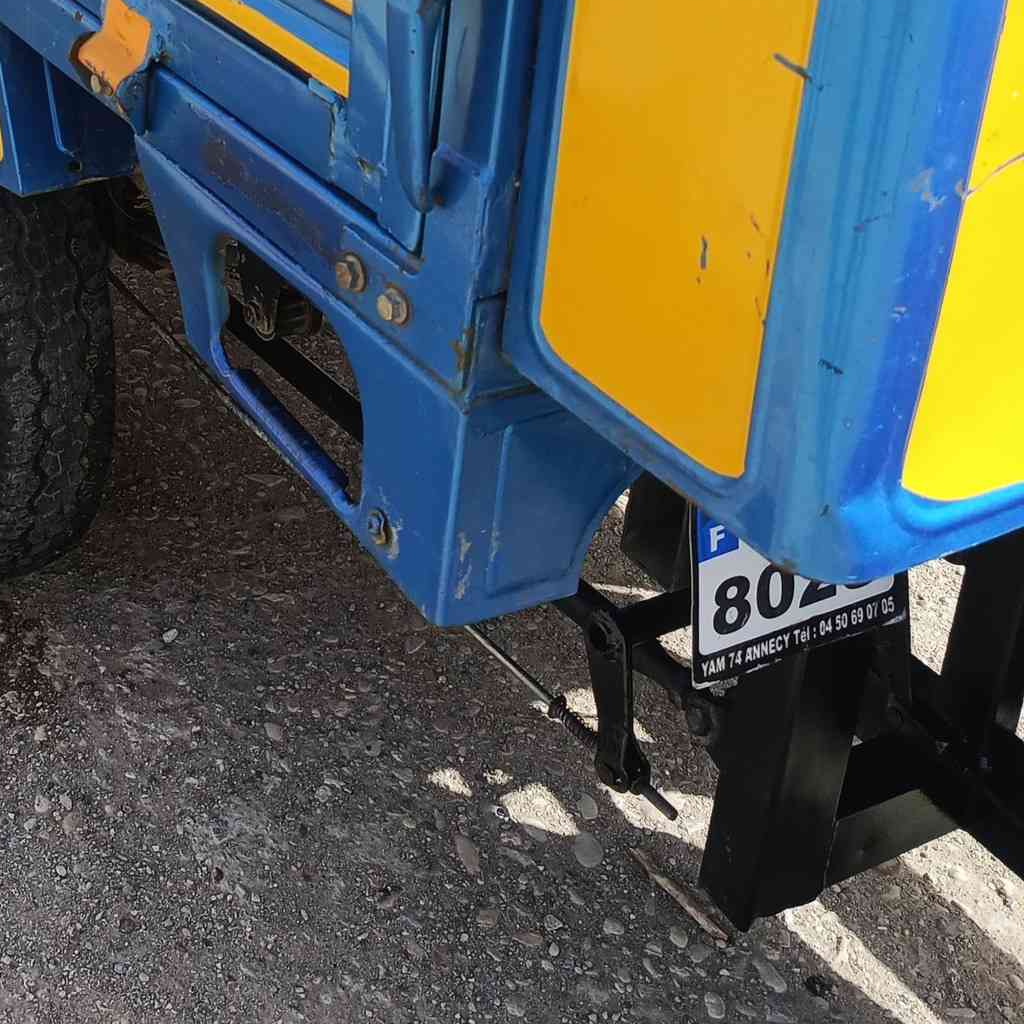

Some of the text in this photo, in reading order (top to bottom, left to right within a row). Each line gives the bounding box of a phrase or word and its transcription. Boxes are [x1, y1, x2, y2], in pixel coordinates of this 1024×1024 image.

[709, 525, 725, 553] F
[701, 656, 726, 677] YAM
[728, 650, 742, 668] 74
[745, 632, 791, 663] ANNECY
[819, 617, 832, 636] 04
[851, 607, 864, 625] 69
[881, 596, 895, 615] 05
